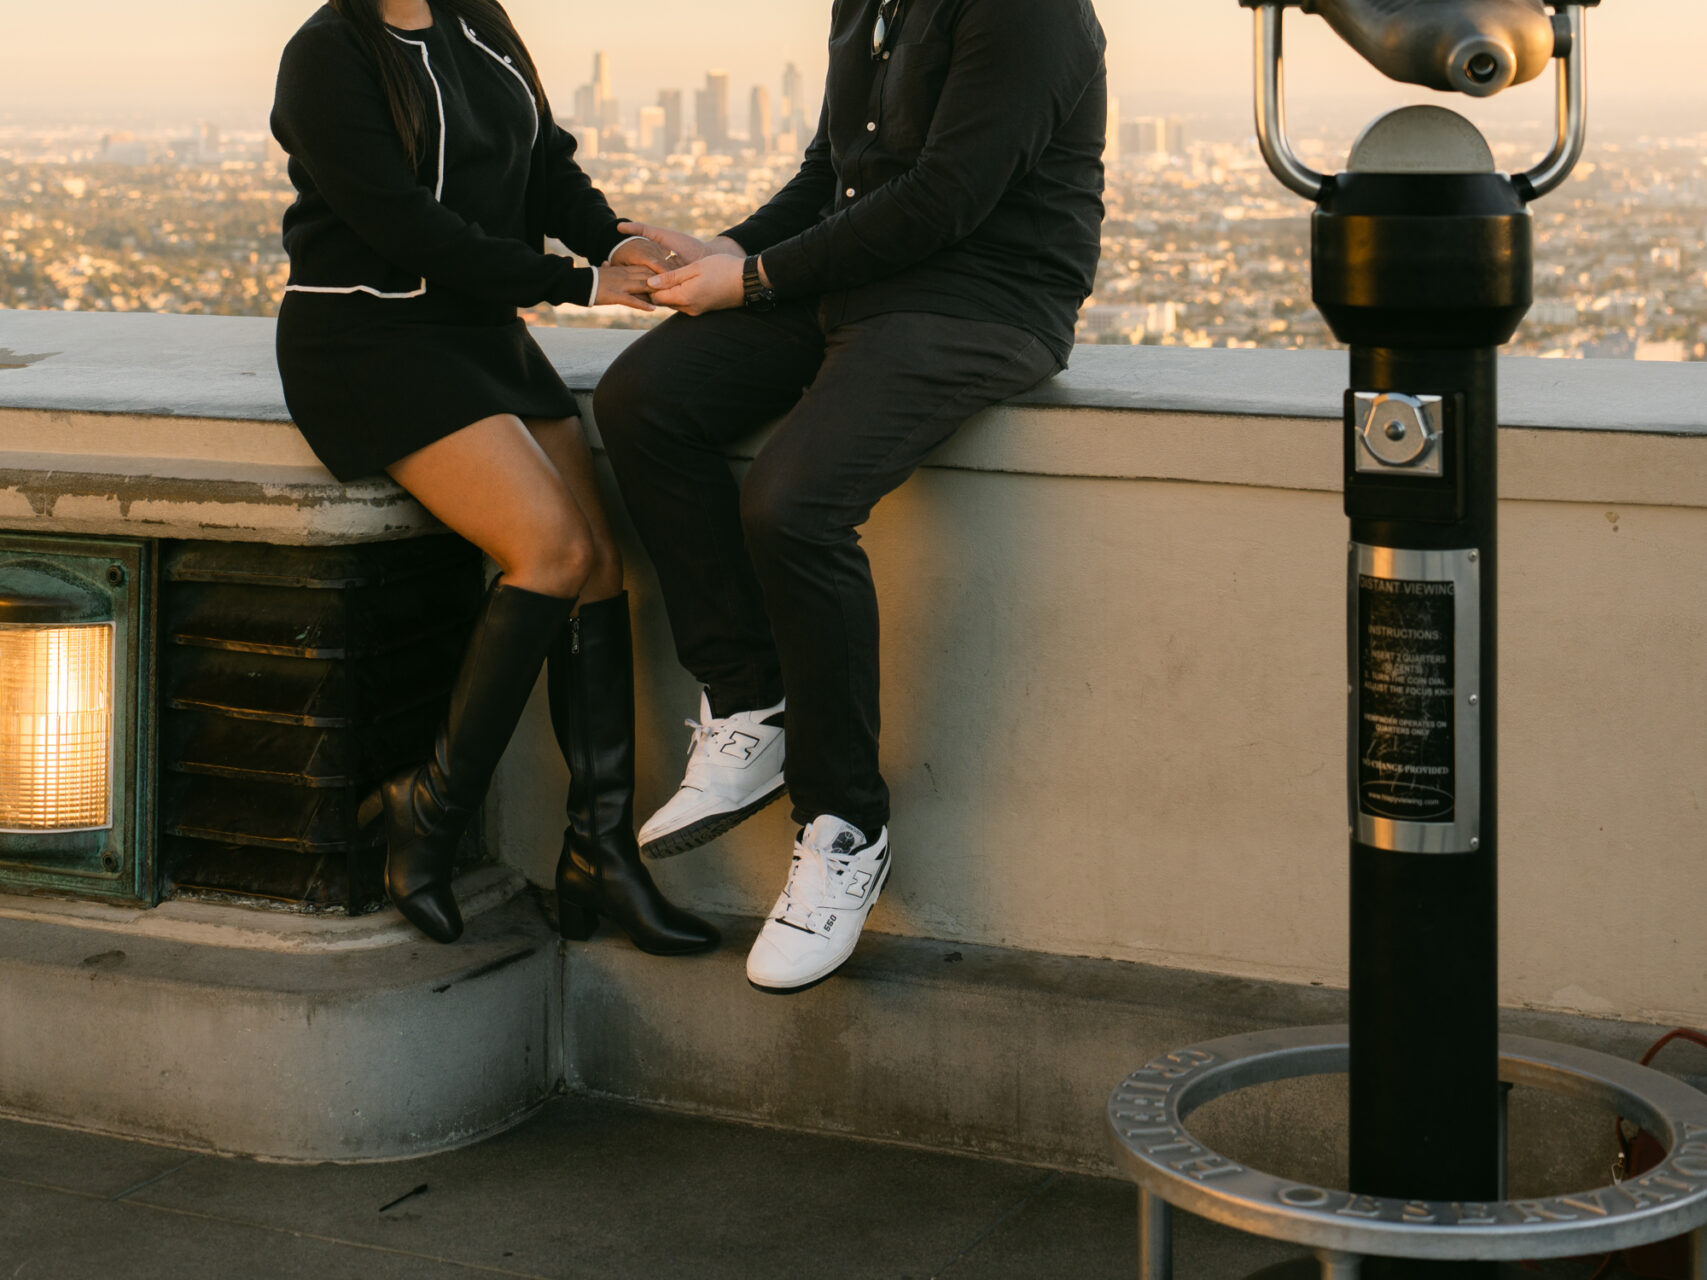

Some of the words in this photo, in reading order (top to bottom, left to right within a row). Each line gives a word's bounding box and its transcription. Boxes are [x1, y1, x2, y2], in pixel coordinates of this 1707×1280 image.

[1360, 575, 1400, 593] DISTANT
[1403, 581, 1454, 596] VIEWING
[1402, 652, 1447, 664] QUARTERS
[1392, 673, 1405, 684] THE
[1429, 677, 1446, 686] DIAL
[1390, 685, 1404, 694] THE
[1405, 686, 1433, 697] FOCUS
[1436, 720, 1447, 729] ON
[1411, 728, 1431, 737] ONLY
[1404, 765, 1449, 776] PROVIDED
[1116, 1049, 1243, 1180] GRIFFITH
